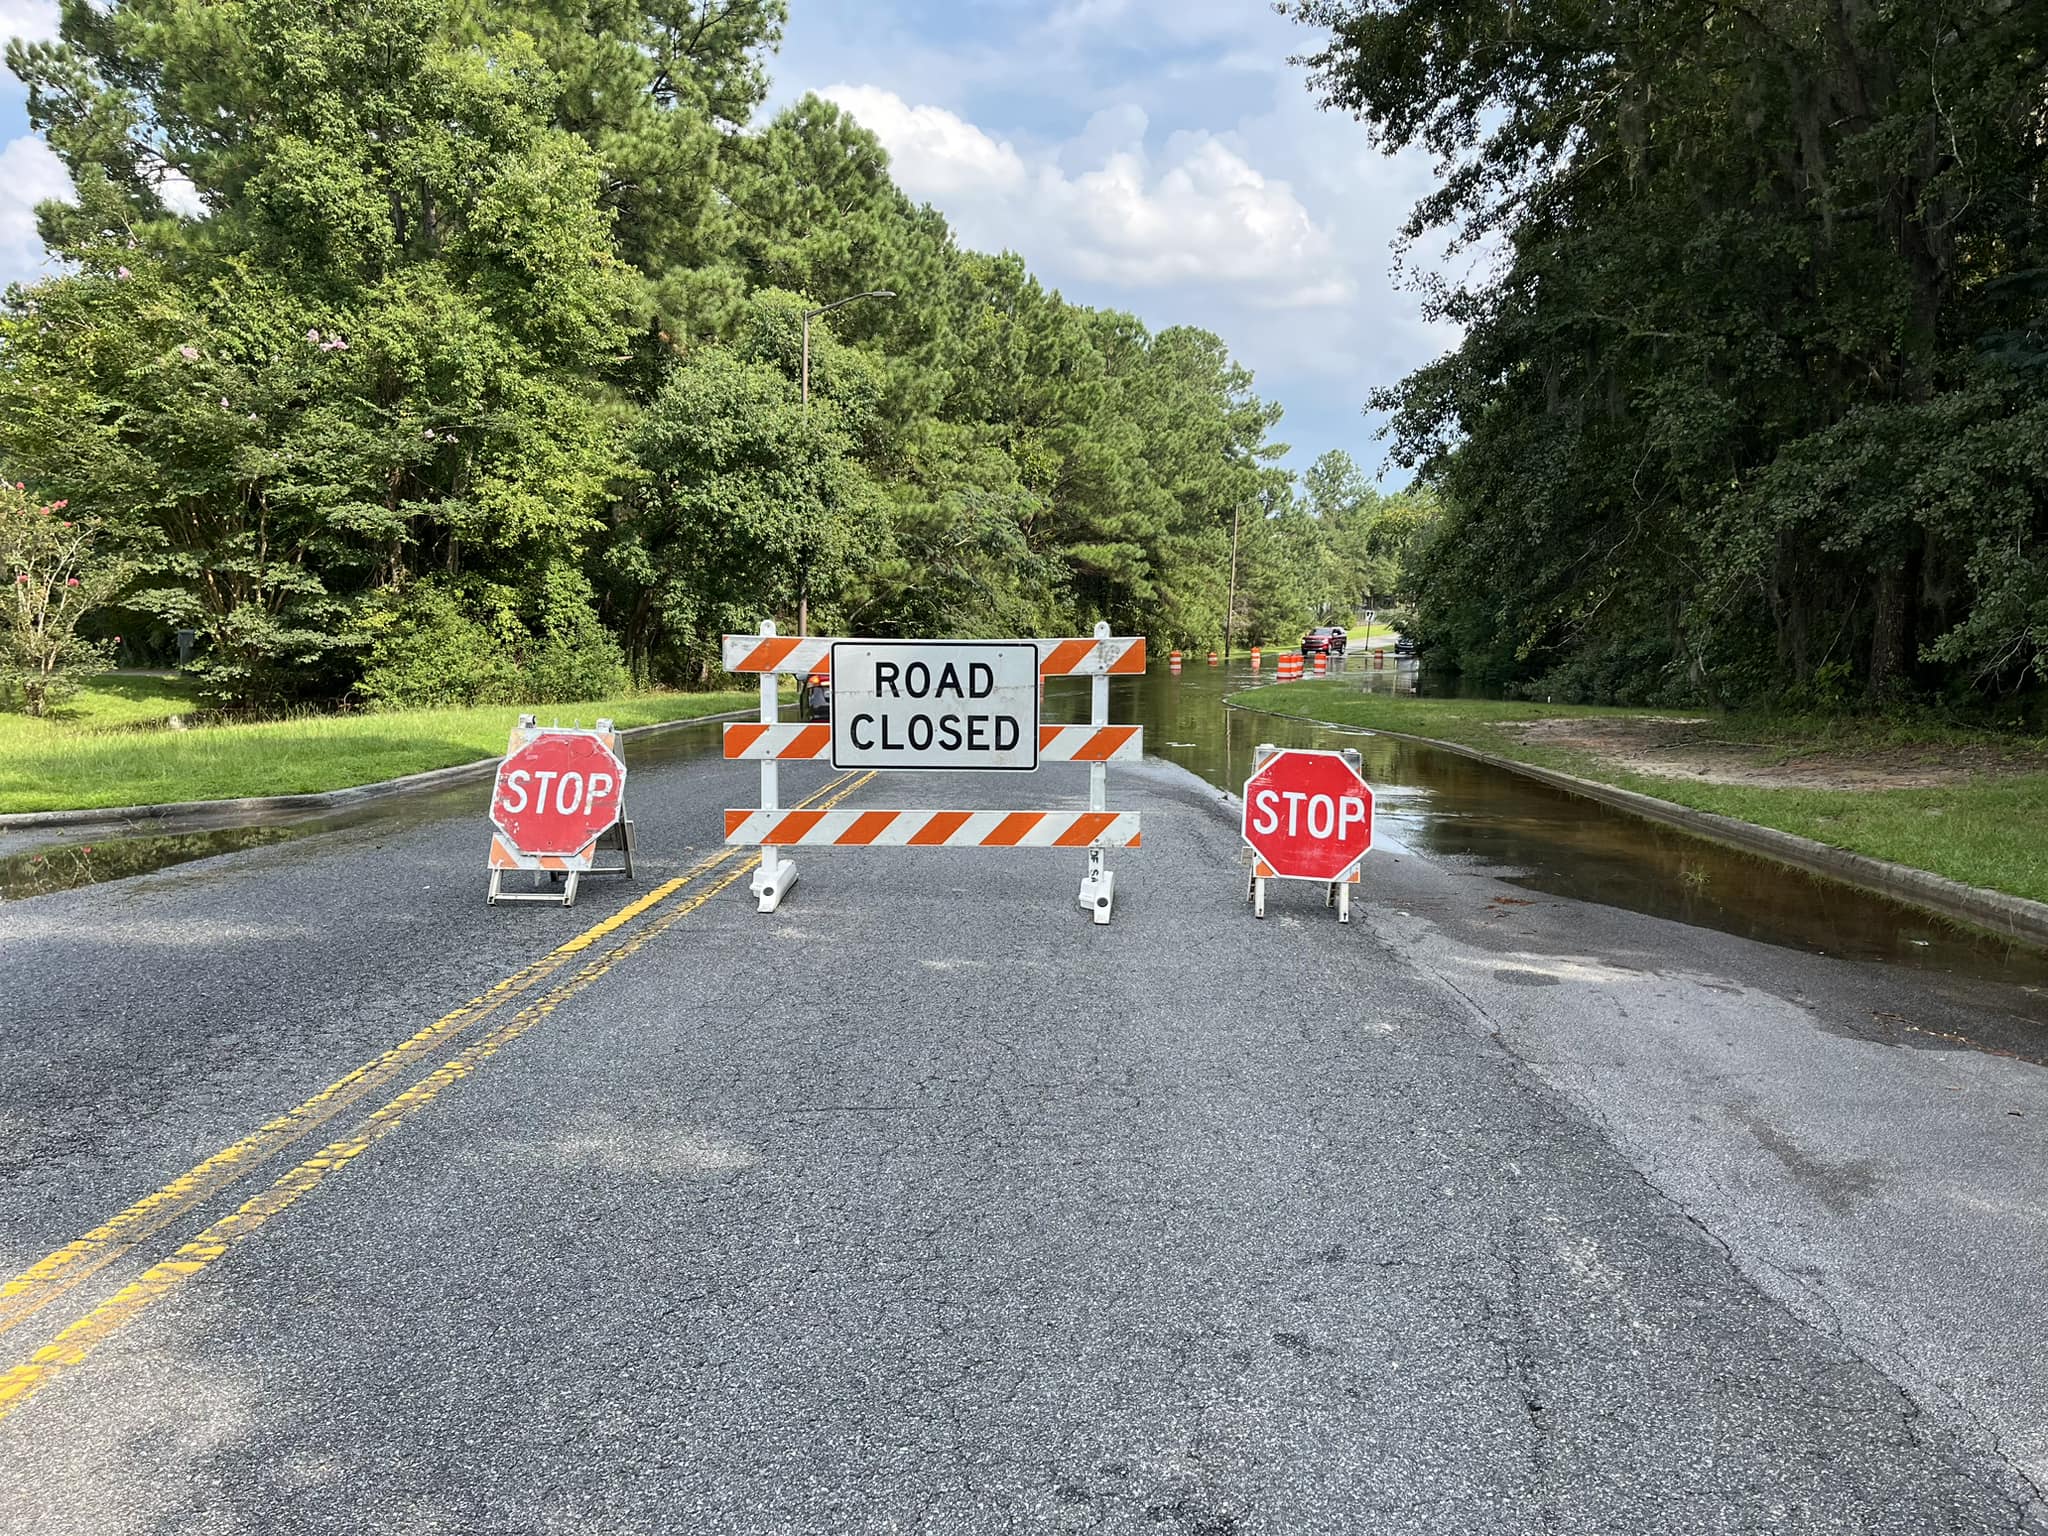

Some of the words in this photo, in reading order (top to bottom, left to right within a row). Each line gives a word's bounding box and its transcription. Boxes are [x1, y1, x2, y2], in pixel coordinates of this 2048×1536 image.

[875, 661, 994, 699] ROAD
[850, 713, 1020, 751] CLOSED
[503, 770, 613, 816] STOP
[1253, 789, 1365, 841] STOP
